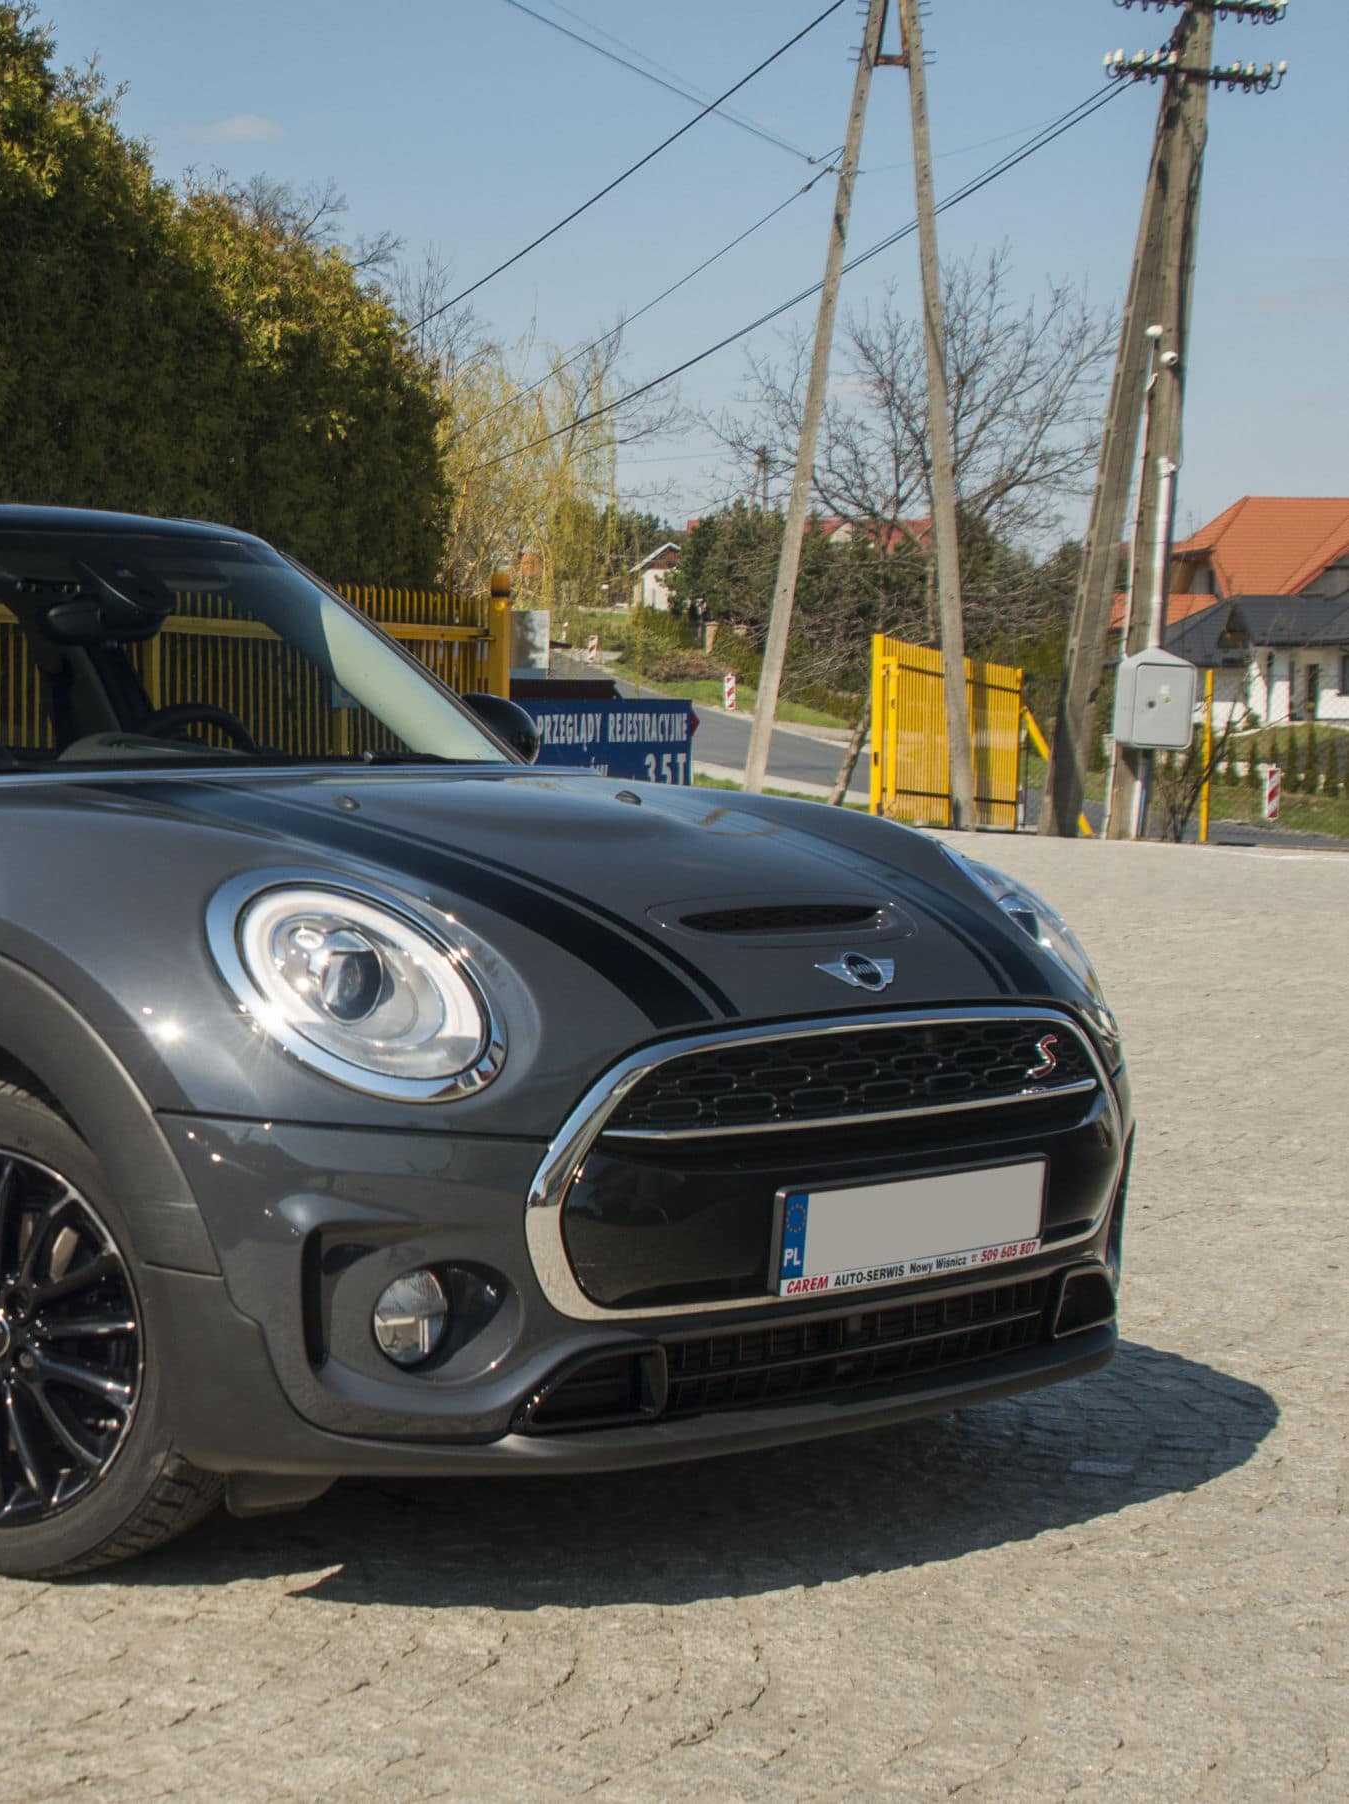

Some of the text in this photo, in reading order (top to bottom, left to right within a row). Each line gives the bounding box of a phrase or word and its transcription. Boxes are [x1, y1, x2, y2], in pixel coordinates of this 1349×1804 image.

[537, 712, 688, 752] PRZEGLĄDY REJESTRACYJNE
[1026, 1034, 1058, 1079] S
[783, 1247, 801, 1267] PL
[787, 1276, 829, 1294] CAREM
[834, 1265, 905, 1287] AUTO-SERWIS
[909, 1260, 933, 1274] Nowy
[981, 1248, 999, 1262] 509
